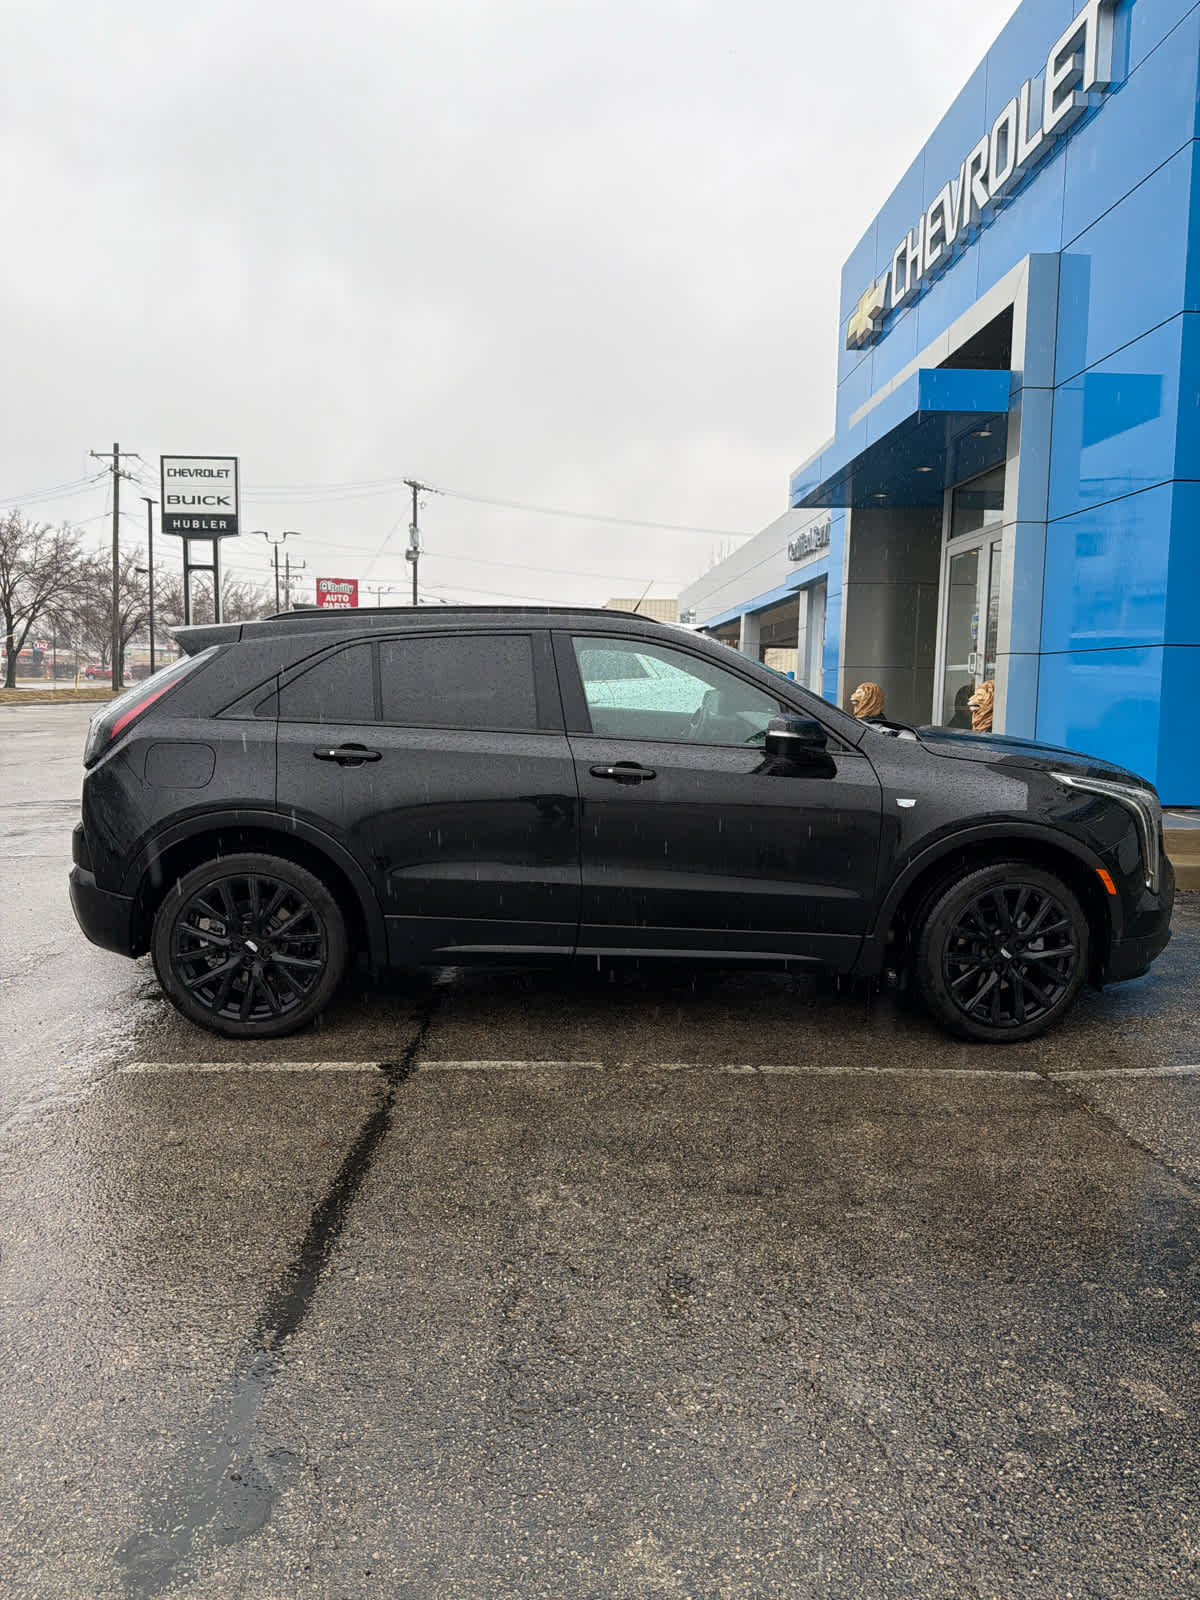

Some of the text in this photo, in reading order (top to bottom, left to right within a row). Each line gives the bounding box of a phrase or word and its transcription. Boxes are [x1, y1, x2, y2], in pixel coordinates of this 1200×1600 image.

[890, 0, 1110, 310] CHEVROLET
[167, 468, 231, 479] CHEVROLET
[167, 495, 231, 506] BUICK
[173, 519, 227, 529] HUBLER
[325, 594, 350, 602] AUTO
